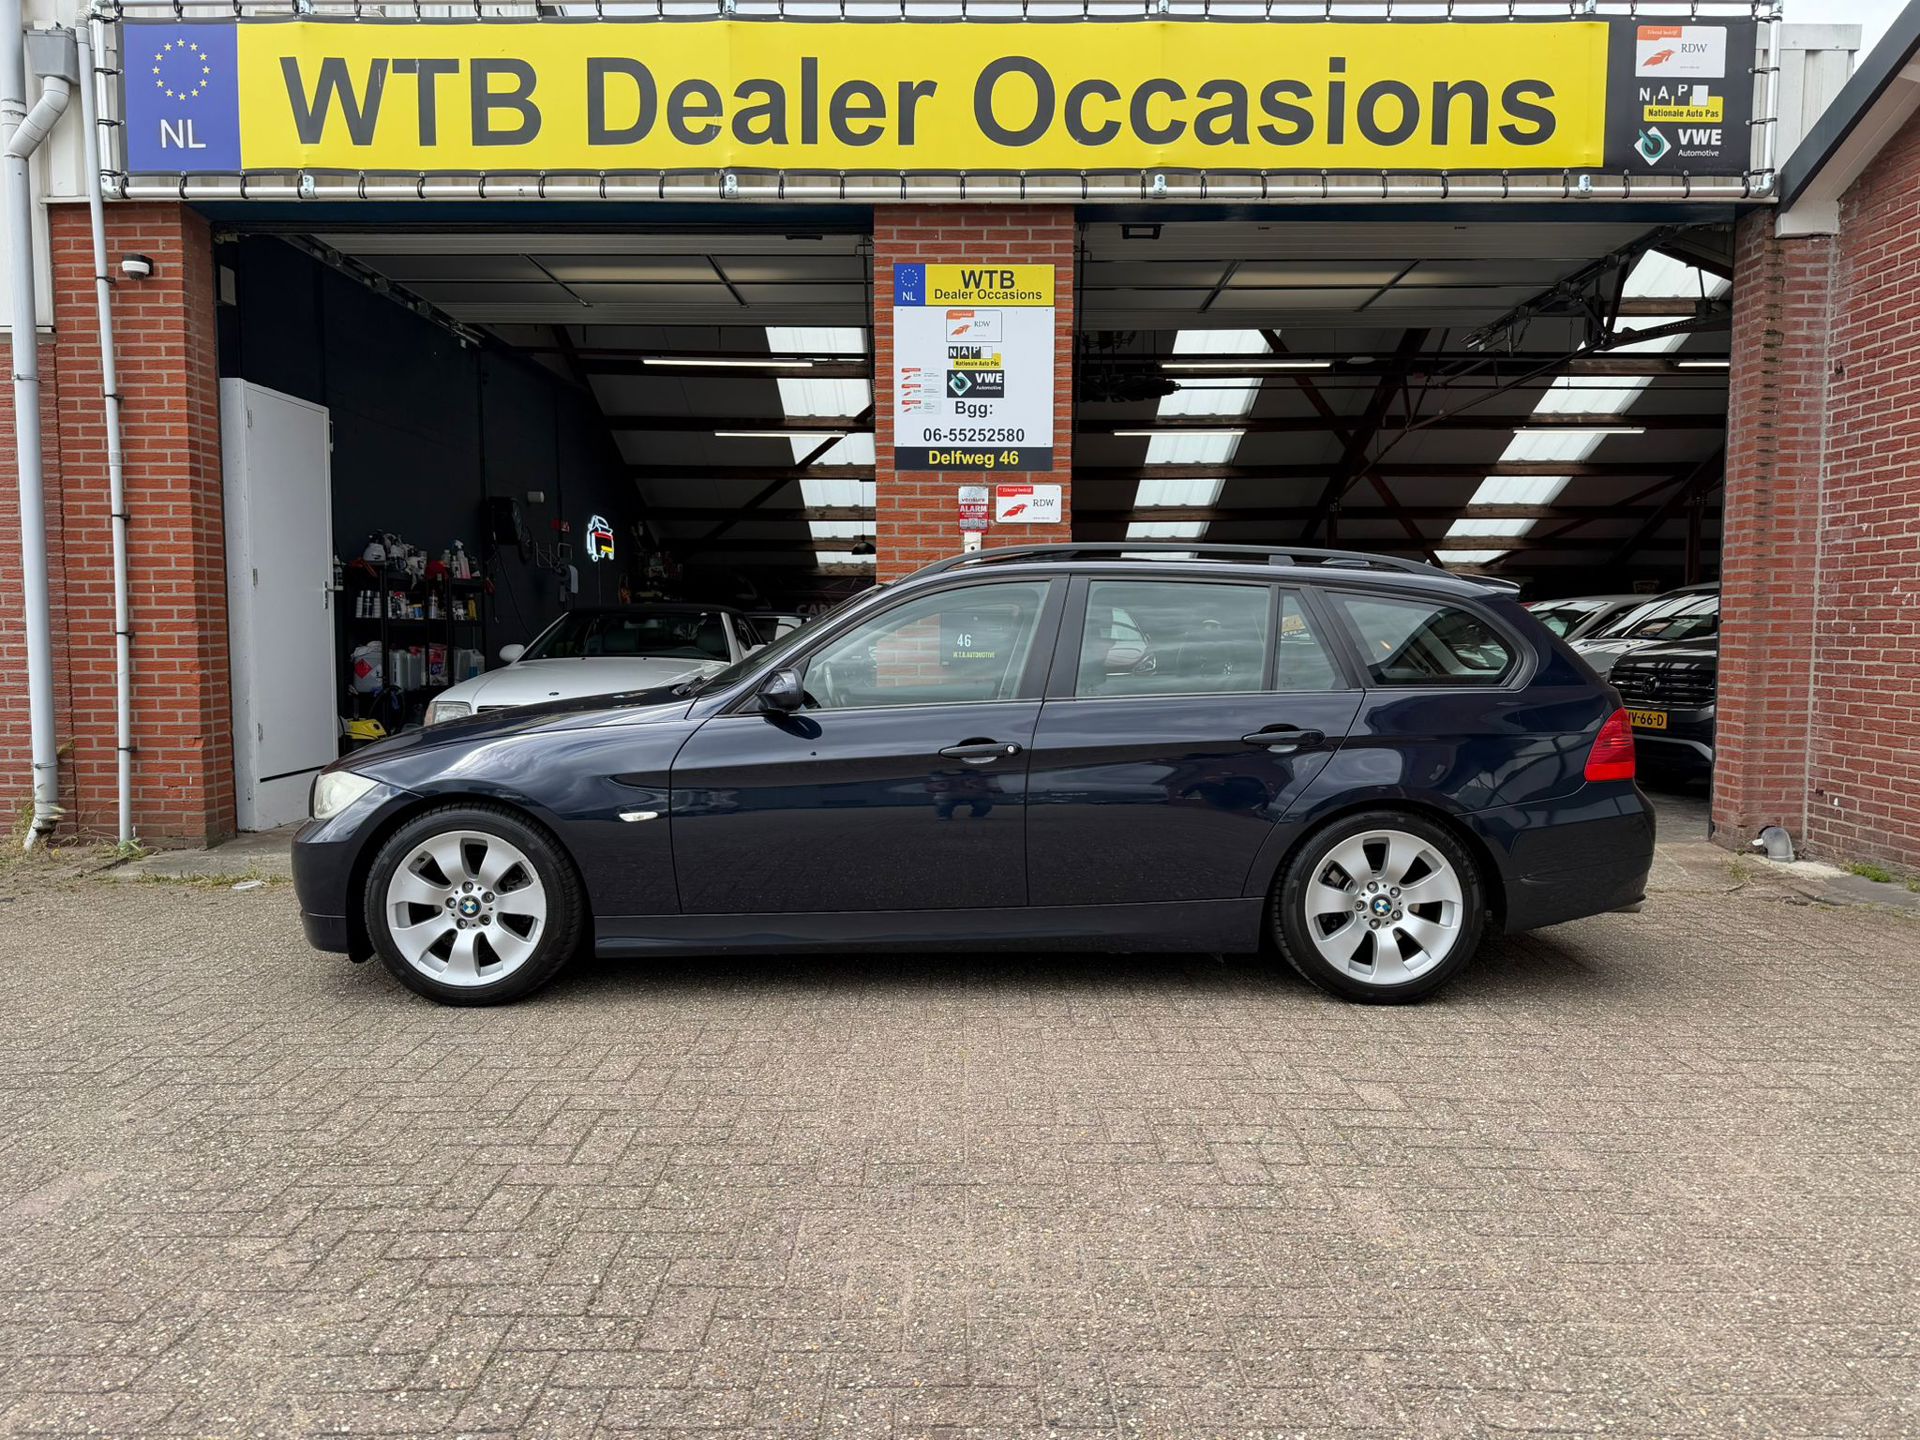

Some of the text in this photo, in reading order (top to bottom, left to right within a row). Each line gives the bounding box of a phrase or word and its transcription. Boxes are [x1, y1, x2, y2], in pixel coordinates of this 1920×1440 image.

[1681, 43, 1708, 53] RDW
[280, 56, 1556, 146] WTB Dealer Occasions
[1648, 108, 1719, 118] Nationale Auto Pas
[160, 119, 207, 149] NL
[1678, 128, 1722, 146] VWE
[1678, 149, 1720, 157] Automotive
[961, 270, 1015, 289] WTB
[902, 292, 916, 301] NL
[934, 288, 1042, 300] Dealer Occasions
[975, 372, 1003, 384] VWE
[955, 401, 993, 418] Bgg:
[923, 428, 1025, 442] 06-55252580
[928, 450, 1019, 468] Delfweg 46
[960, 505, 988, 513] ALARM
[1033, 499, 1055, 507] RDW
[956, 632, 973, 648] 46
